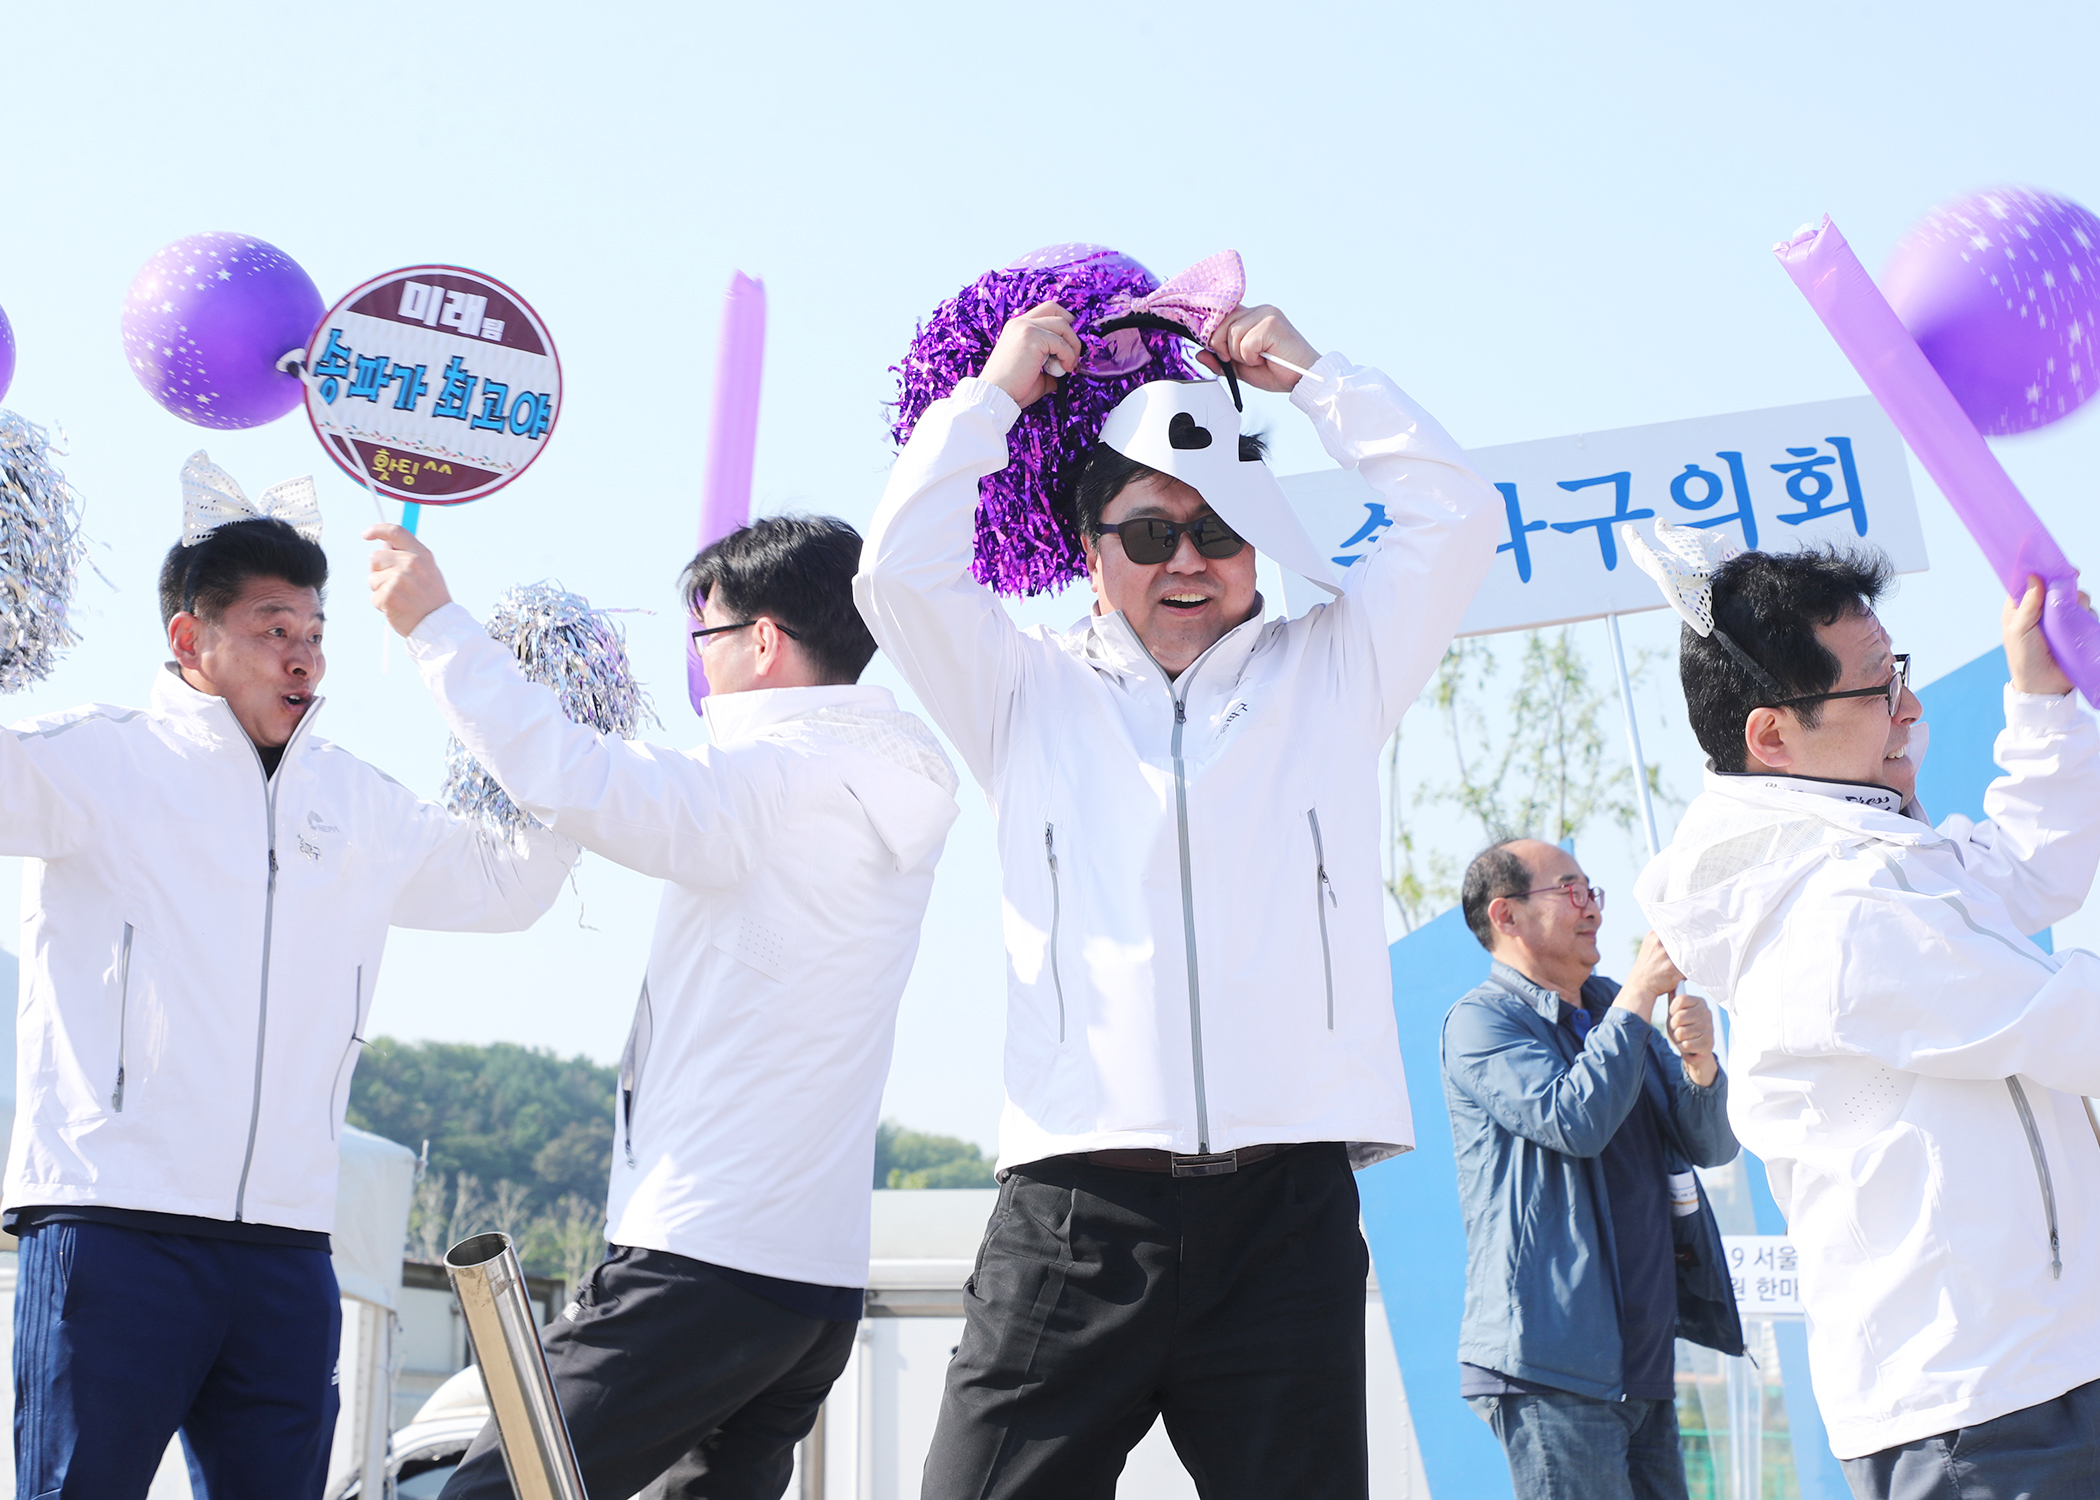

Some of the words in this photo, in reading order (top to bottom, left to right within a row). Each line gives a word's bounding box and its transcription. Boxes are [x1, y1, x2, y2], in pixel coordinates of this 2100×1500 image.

[313, 328, 429, 411] 송파가
[432, 355, 552, 440] 최고야
[1331, 436, 1869, 584] 구의회
[1753, 1246, 1798, 1271] 서울
